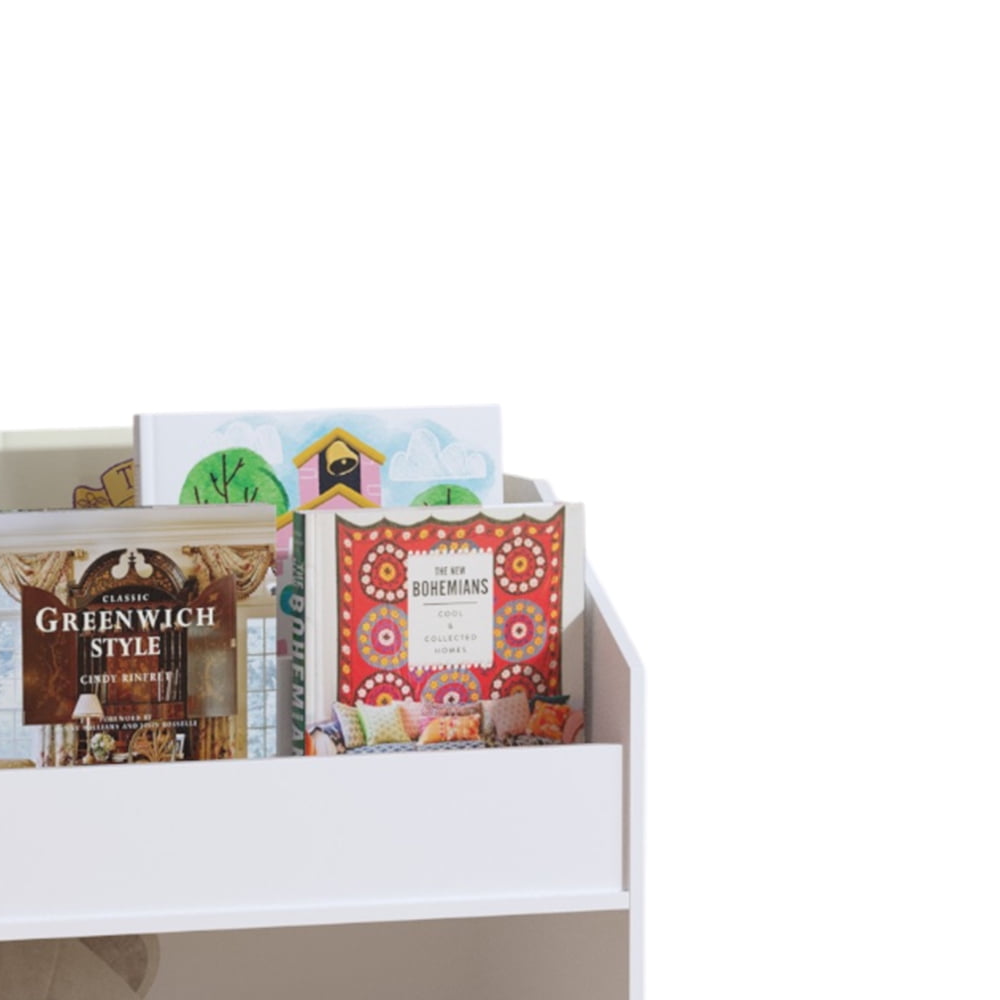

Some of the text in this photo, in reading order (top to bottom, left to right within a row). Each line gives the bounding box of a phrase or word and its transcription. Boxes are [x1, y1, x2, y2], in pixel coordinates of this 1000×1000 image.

[435, 566, 466, 576] THE NEW
[412, 578, 489, 597] BOHEMIANS
[102, 593, 150, 603] CLASSIC
[35, 606, 216, 633] GREENWICH
[438, 610, 463, 618] COOL
[424, 633, 477, 643] COLLECTED
[91, 636, 161, 658] STYLE
[80, 673, 116, 685] CINDY
